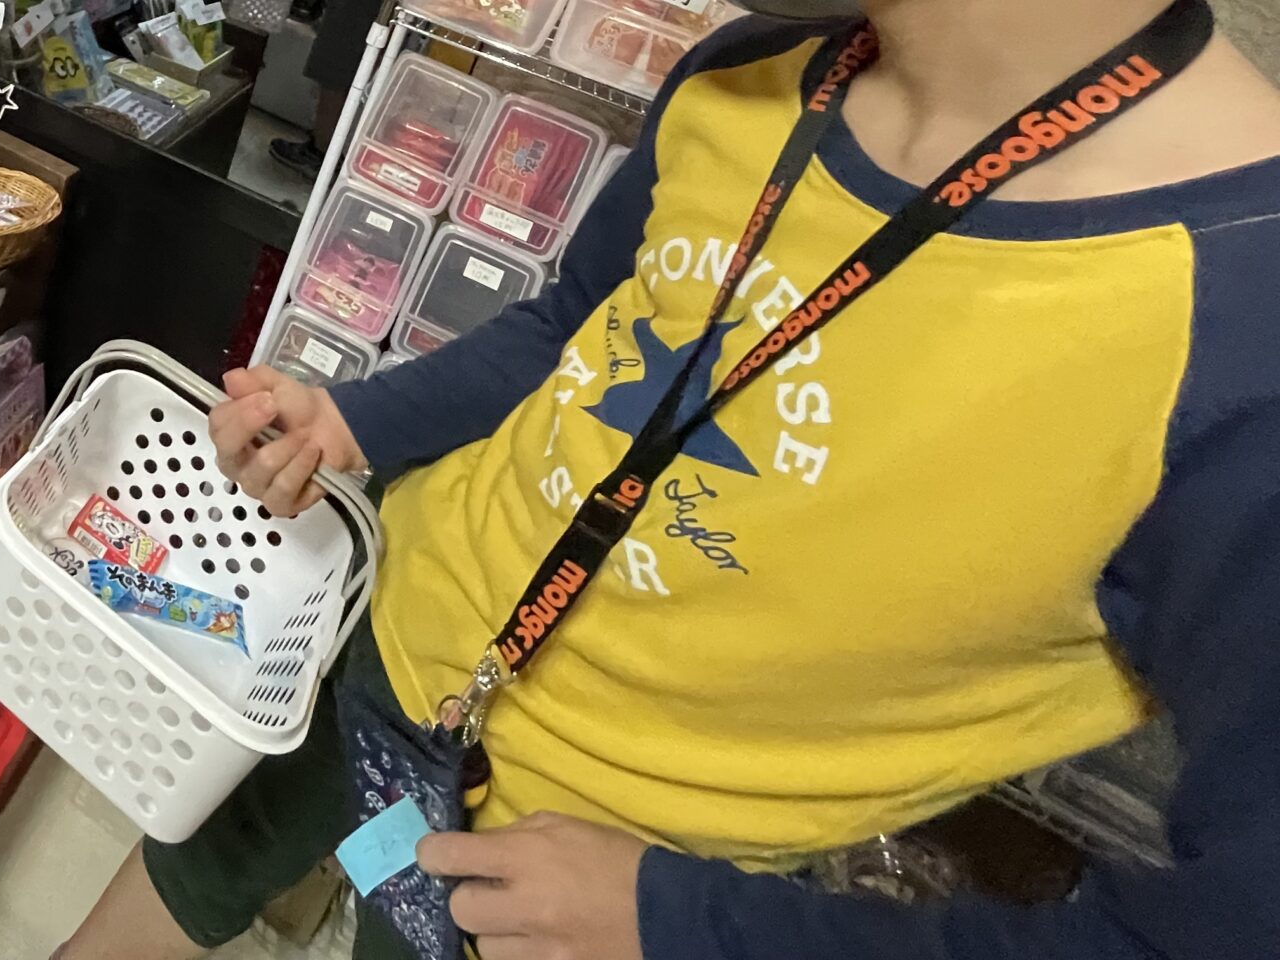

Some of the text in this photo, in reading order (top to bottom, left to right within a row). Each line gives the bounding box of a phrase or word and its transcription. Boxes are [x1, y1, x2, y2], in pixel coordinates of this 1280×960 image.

[106, 565, 177, 601] そのまんま
